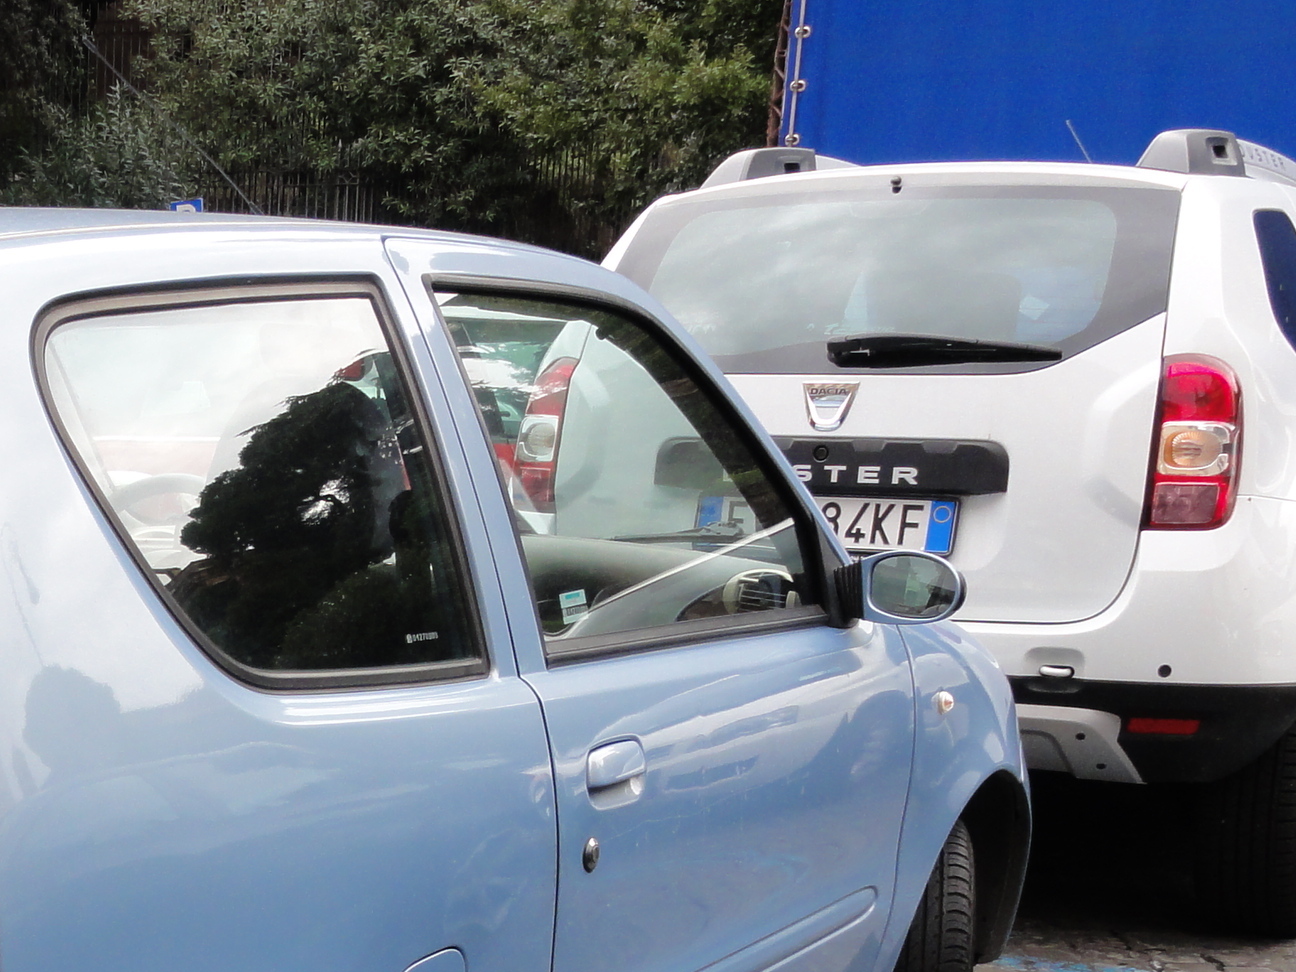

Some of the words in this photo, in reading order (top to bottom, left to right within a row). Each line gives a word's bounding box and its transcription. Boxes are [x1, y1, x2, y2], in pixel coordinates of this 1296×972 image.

[810, 387, 847, 395] DACIA
[791, 464, 918, 485] STER
[820, 501, 924, 546] 84KF
